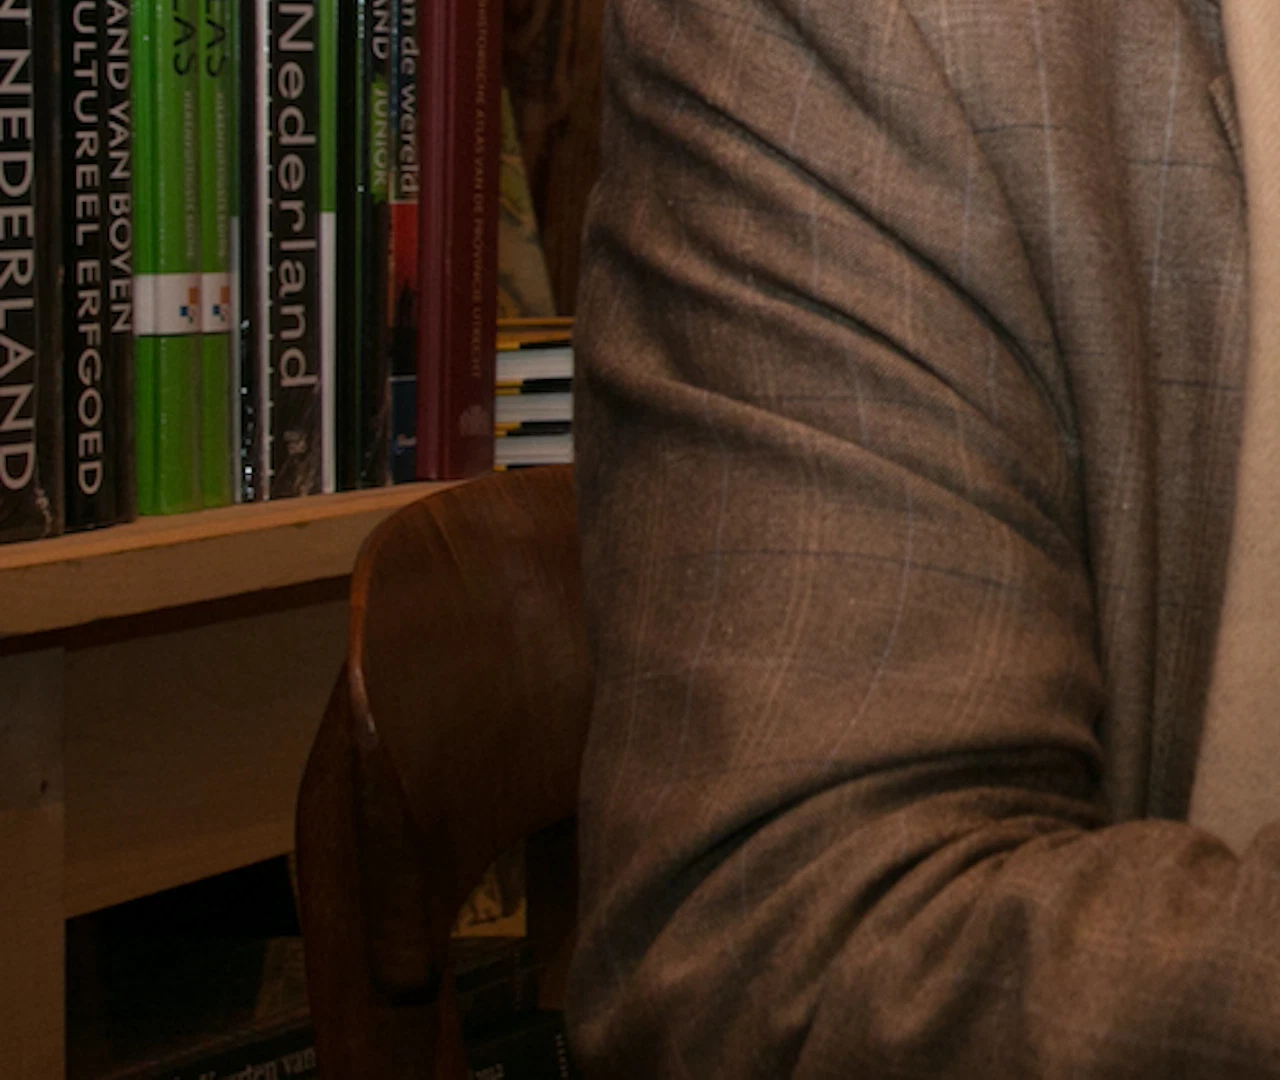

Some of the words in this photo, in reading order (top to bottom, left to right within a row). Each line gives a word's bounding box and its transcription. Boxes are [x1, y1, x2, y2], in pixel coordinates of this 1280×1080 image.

[401, 36, 421, 75] de
[106, 99, 131, 181] VAN
[372, 84, 389, 187] JUNIOR
[400, 83, 420, 192] wereld
[474, 108, 488, 153] ATLAS
[474, 155, 488, 191] VAN
[277, 2, 318, 387] Nederland
[473, 194, 487, 215] DE
[0, 48, 36, 492] NEDERLAND
[108, 191, 133, 335] BOVEN
[472, 217, 487, 302] PROVINCIE
[76, 259, 103, 495] ERFGOED
[470, 306, 484, 378] UTRECHT
